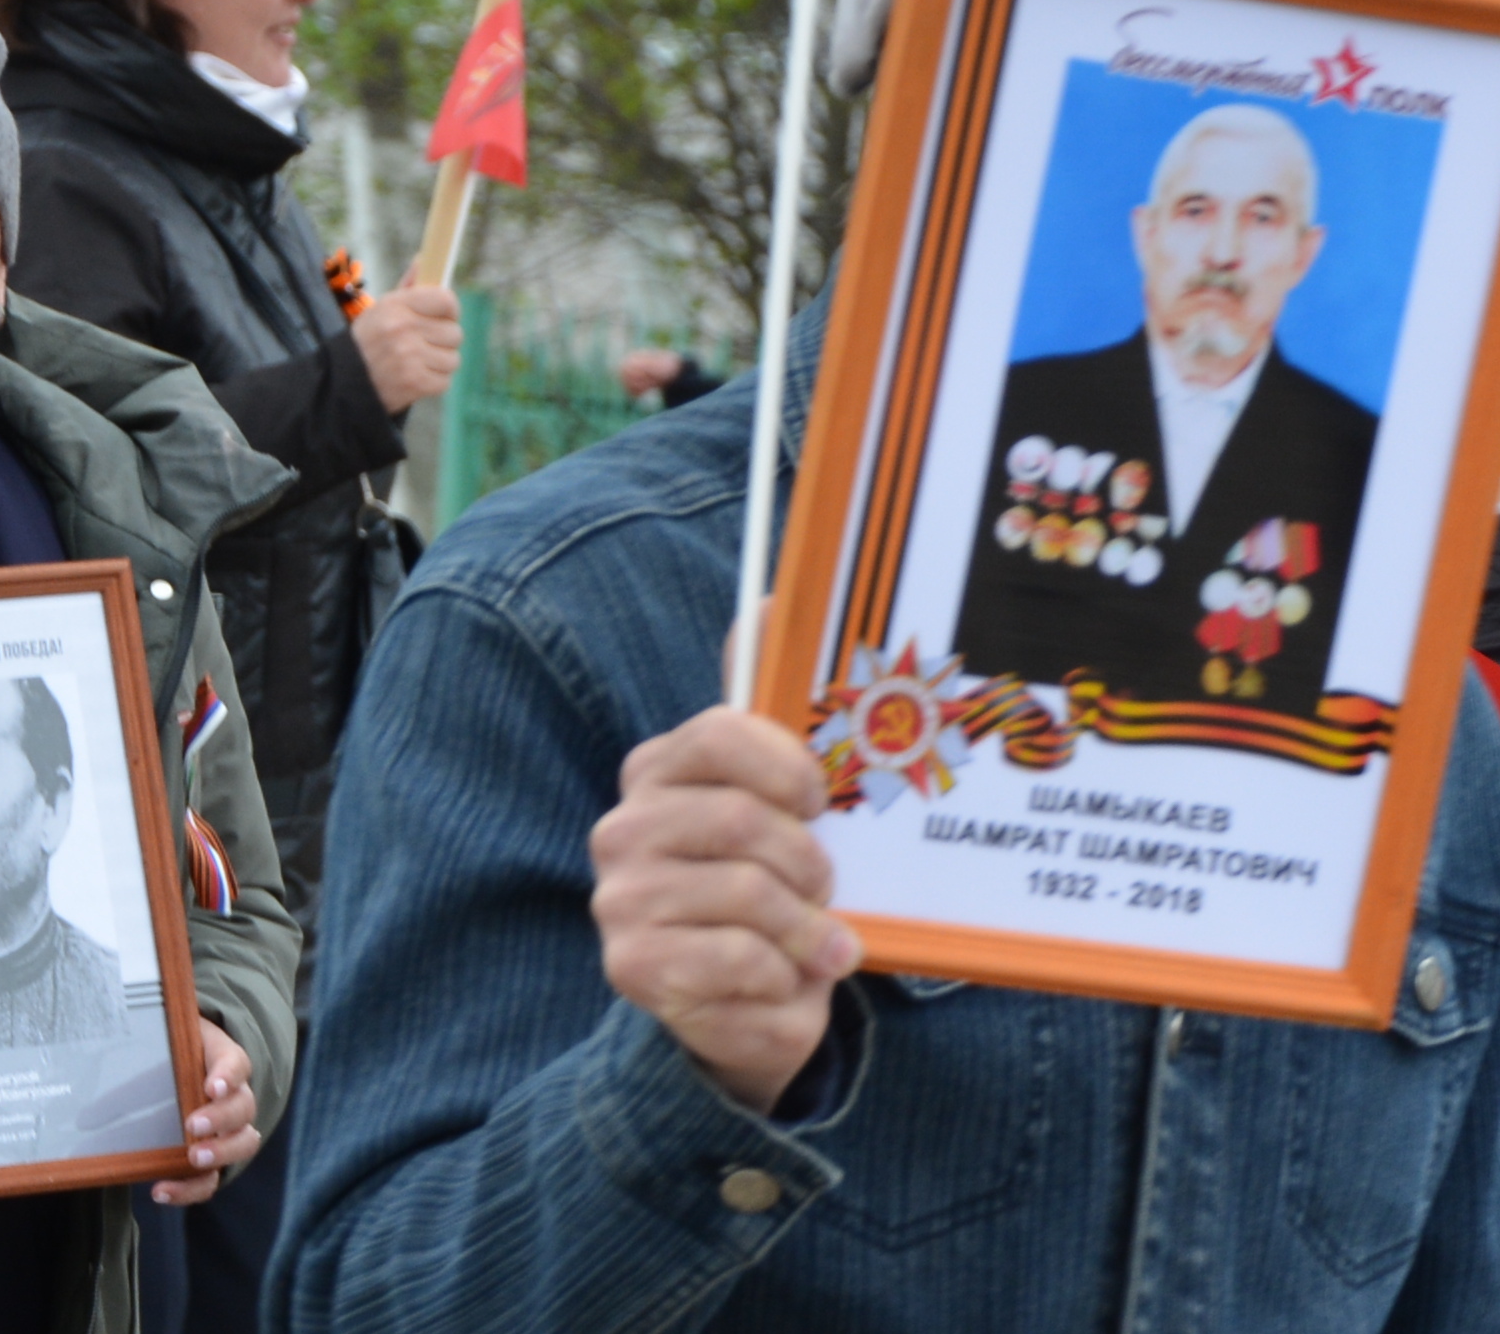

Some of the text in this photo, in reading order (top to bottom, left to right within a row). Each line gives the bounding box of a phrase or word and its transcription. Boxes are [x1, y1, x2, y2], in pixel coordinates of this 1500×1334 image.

[3, 638, 63, 660] ПОБЕДА!
[1029, 785, 1232, 833] ШАМЫКАЕВ
[924, 814, 1320, 887] ШАМРАТ ШАМРАТОВИЧ
[1028, 869, 1099, 900] 1932
[1127, 879, 1205, 914] 2018
